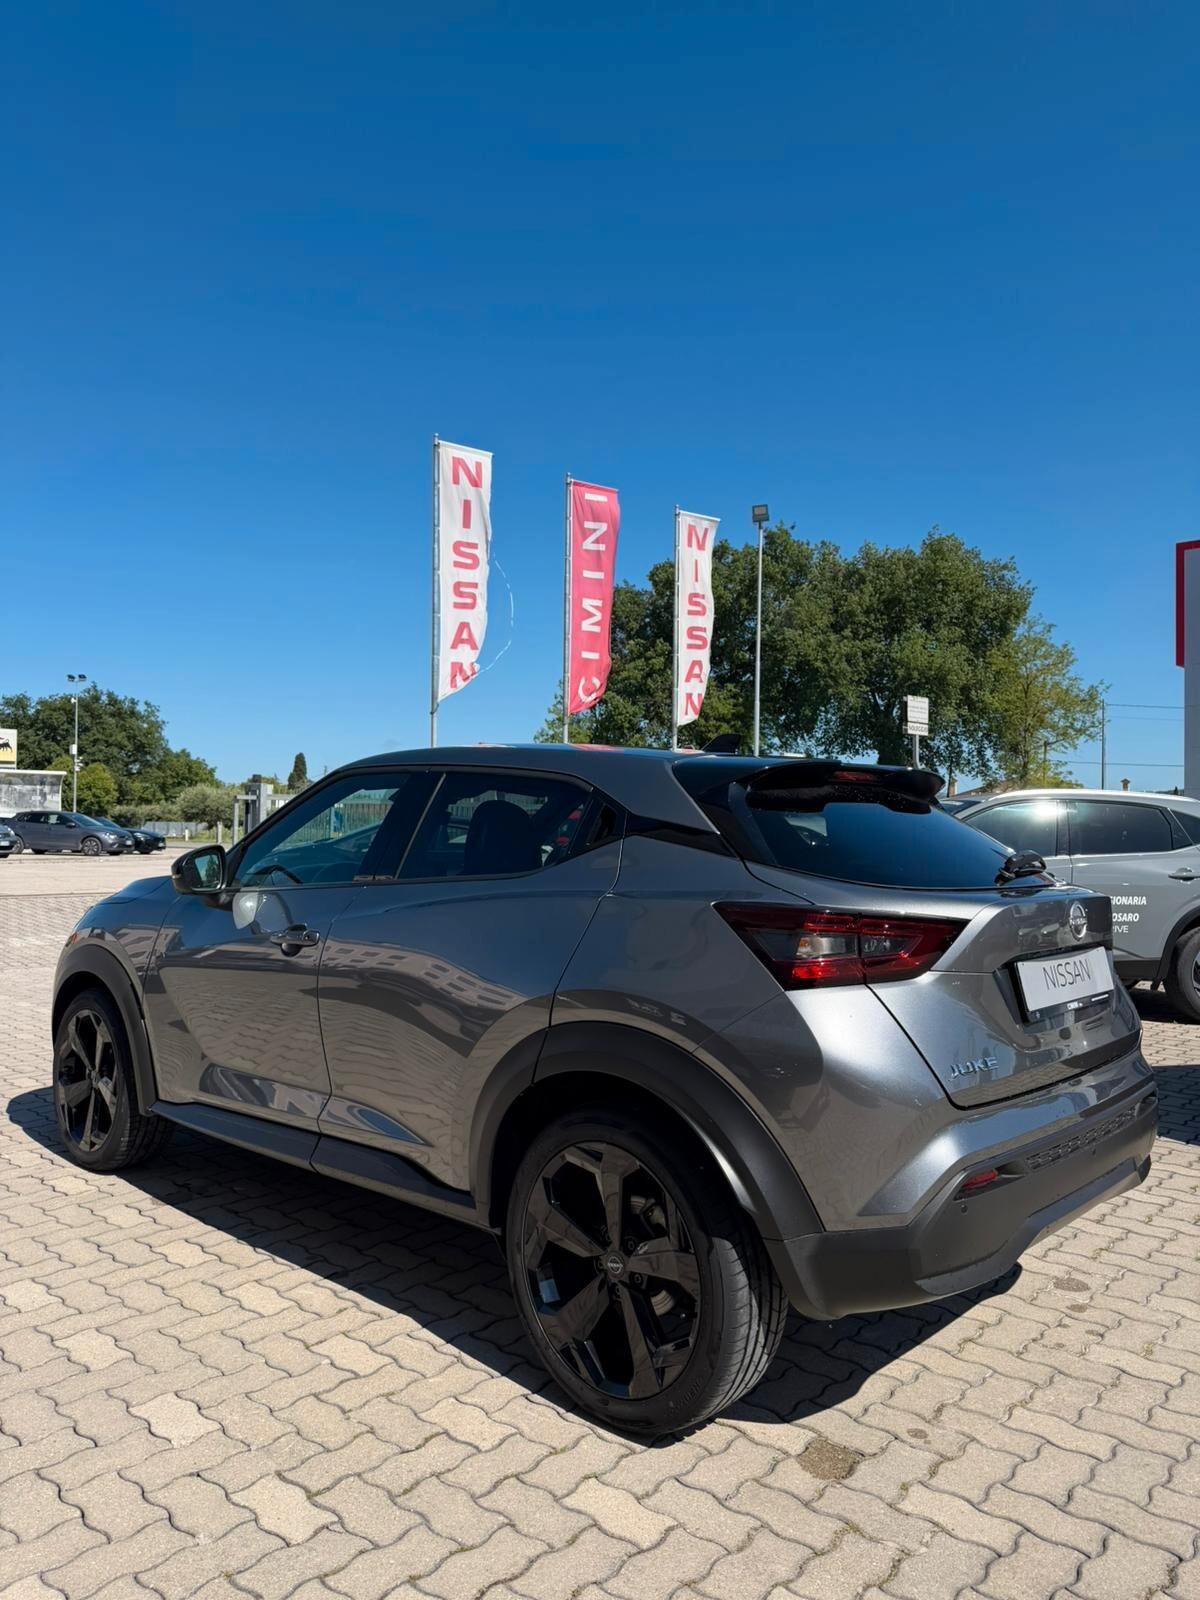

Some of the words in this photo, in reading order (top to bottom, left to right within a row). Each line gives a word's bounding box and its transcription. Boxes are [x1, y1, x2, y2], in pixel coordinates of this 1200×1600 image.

[450, 456, 483, 688] NISSAN
[578, 493, 608, 703] CIMINI
[685, 524, 708, 716] NISSAN
[1042, 959, 1091, 990] NISSAN
[1112, 924, 1129, 934] IVE
[949, 1056, 999, 1079] JUKE
